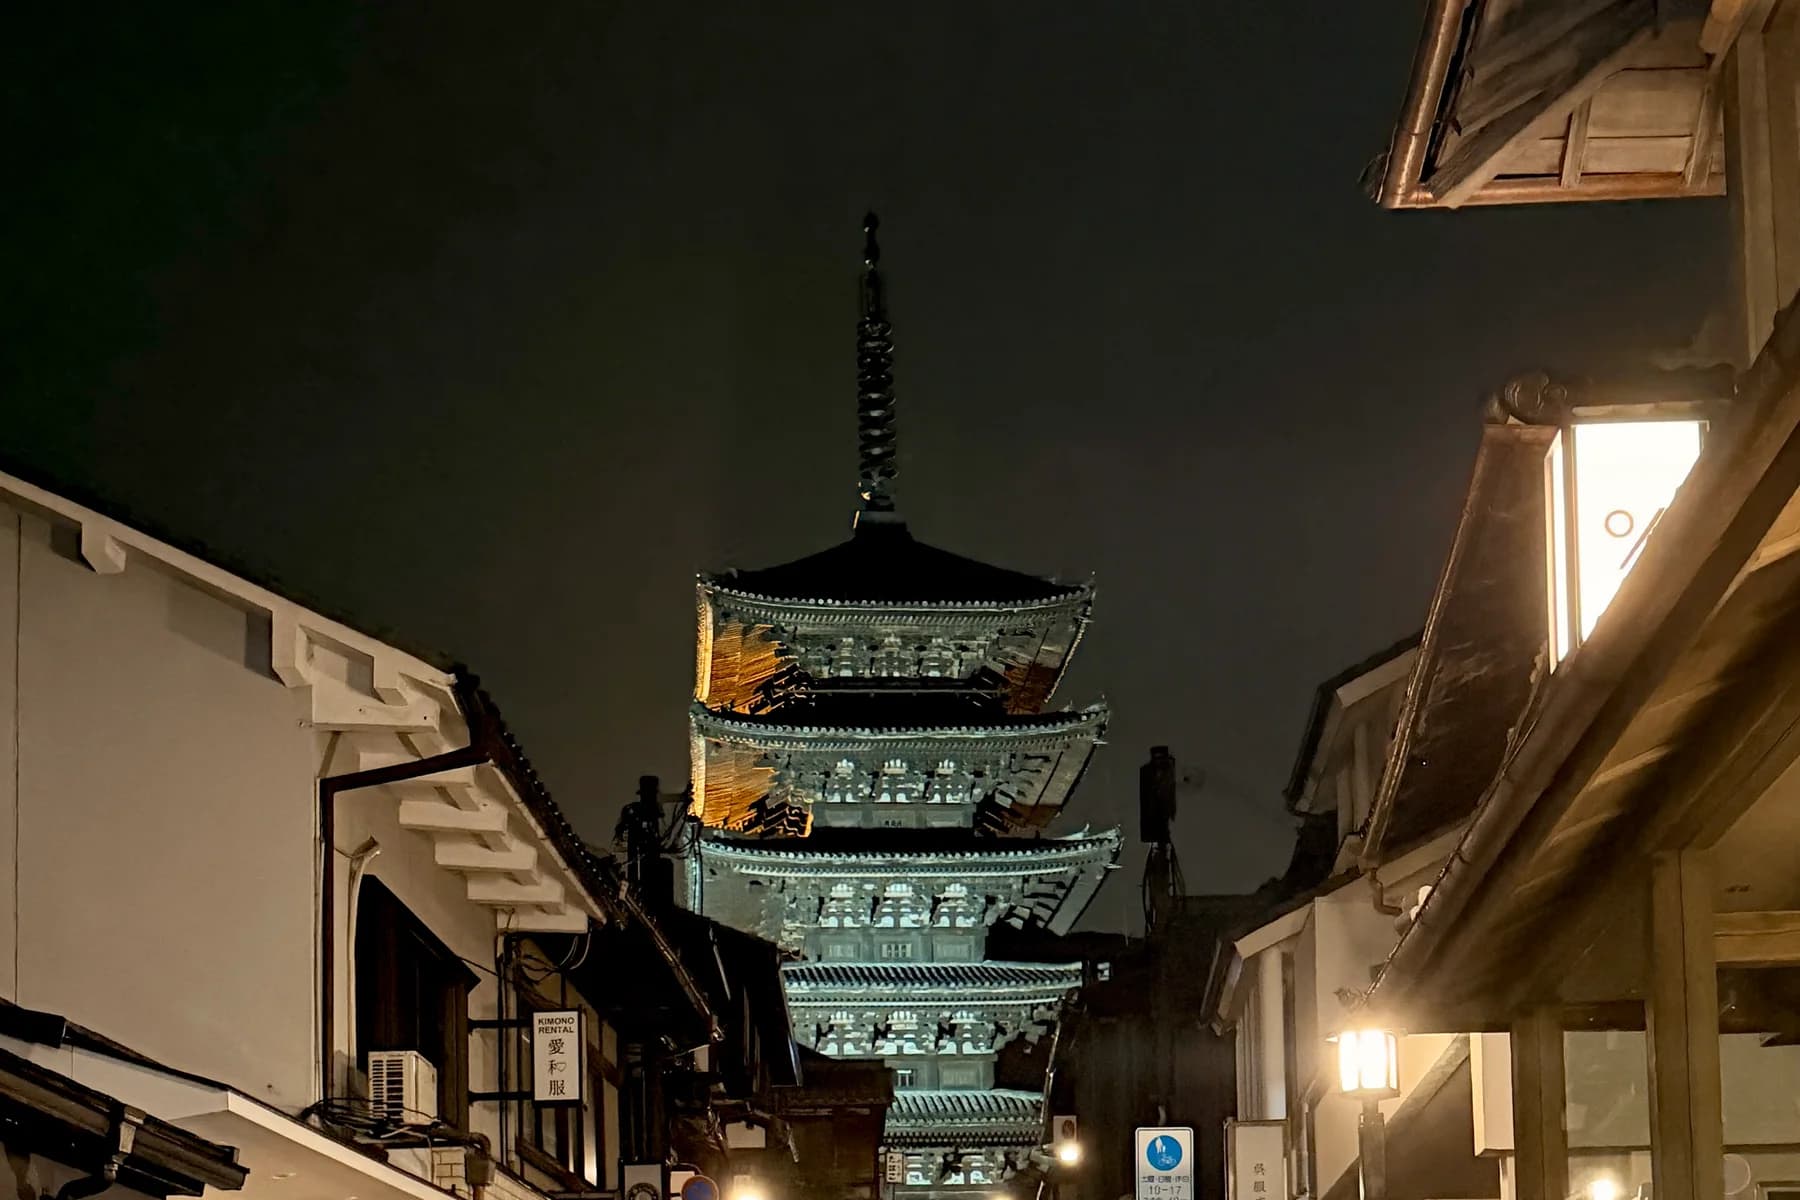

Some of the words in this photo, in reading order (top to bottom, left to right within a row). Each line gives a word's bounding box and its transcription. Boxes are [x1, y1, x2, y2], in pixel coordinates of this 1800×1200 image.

[538, 1017, 575, 1025] KIMONO
[538, 1026, 575, 1034] RENTAL
[548, 1039, 567, 1096] 愛和服
[1149, 1185, 1182, 1195] 10-17
